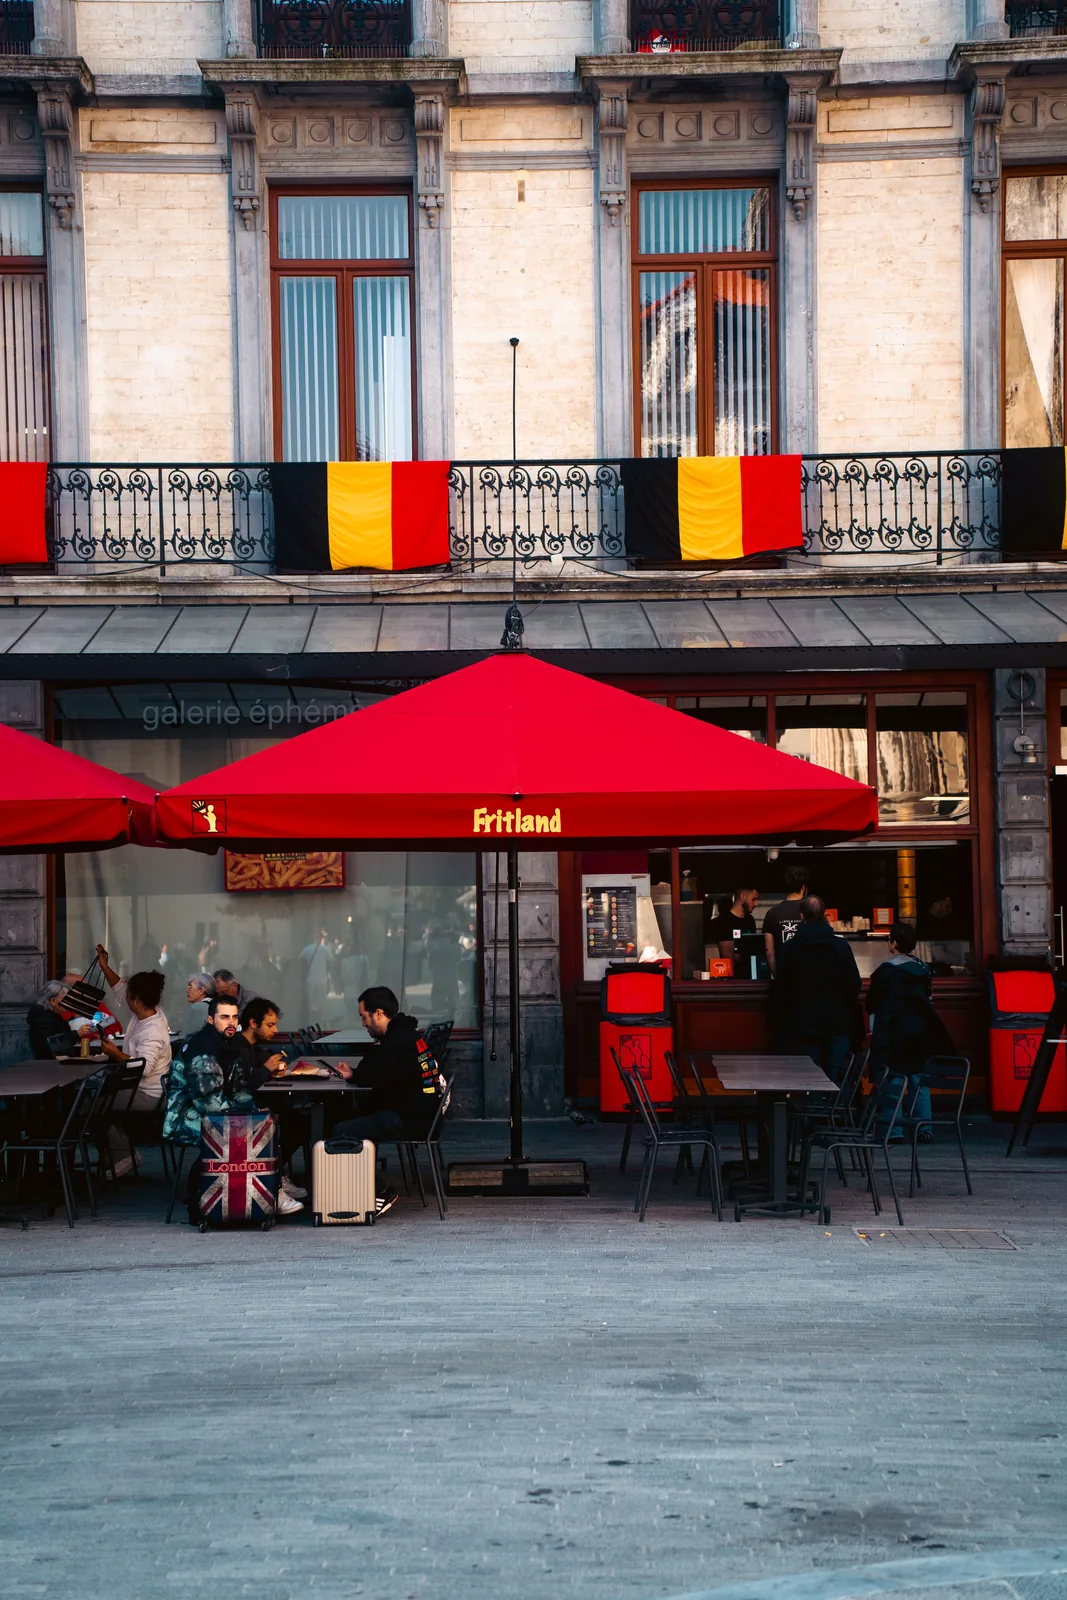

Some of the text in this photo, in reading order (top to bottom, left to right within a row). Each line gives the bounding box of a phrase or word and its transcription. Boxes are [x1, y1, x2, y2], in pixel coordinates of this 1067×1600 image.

[142, 699, 241, 731] galerie
[473, 807, 562, 833] Fritland
[208, 1159, 267, 1172] London
